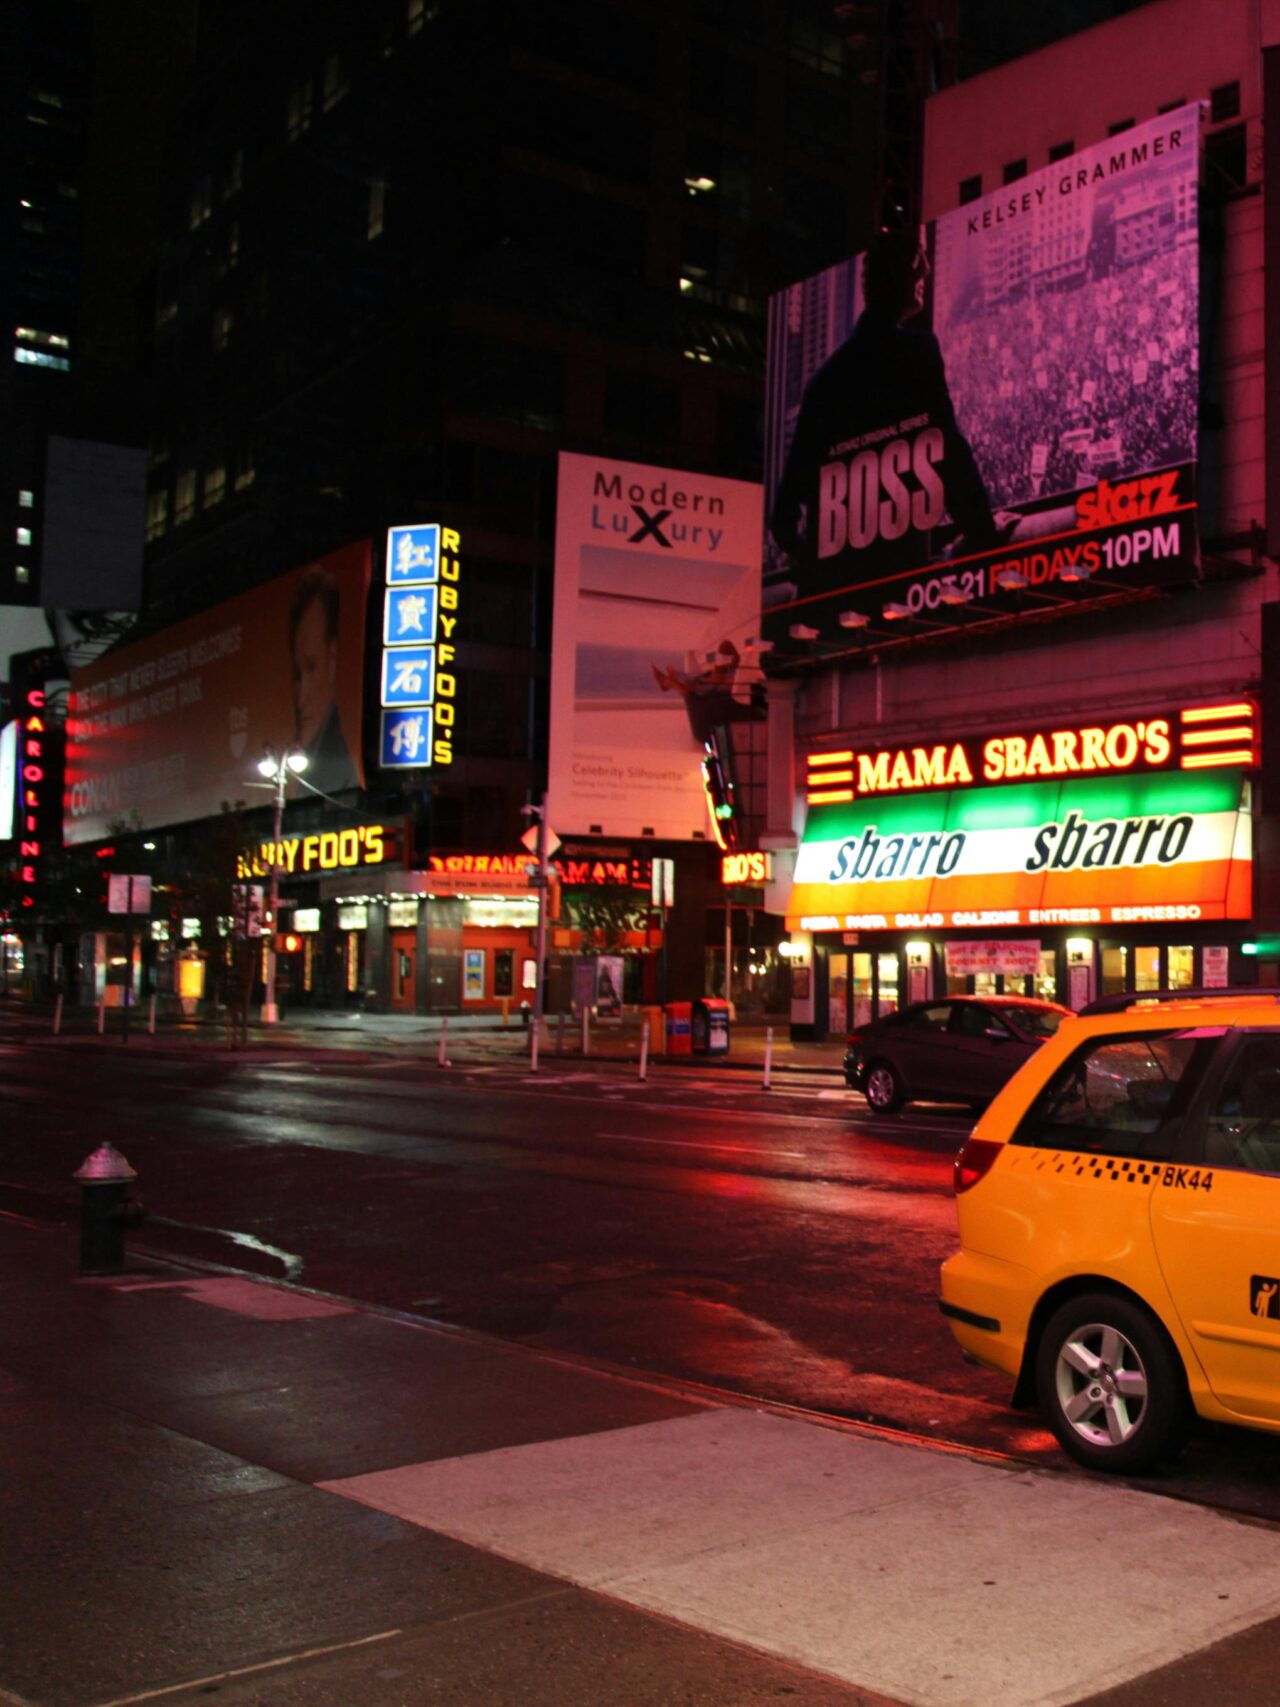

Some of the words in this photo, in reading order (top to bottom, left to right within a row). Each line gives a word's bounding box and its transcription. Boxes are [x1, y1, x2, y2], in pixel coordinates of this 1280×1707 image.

[967, 186, 1047, 235] KELSEY
[1058, 129, 1183, 196] GRAMMER
[593, 471, 724, 516] Modern
[817, 427, 945, 560] BOSS
[1075, 469, 1181, 531] starz
[989, 540, 1101, 595] FRIDAYS
[1101, 522, 1180, 569] 10PM
[857, 743, 973, 793] MAMA
[983, 720, 1171, 781] SBARRO'S
[303, 825, 384, 871] FOO'S
[829, 829, 968, 882] sbarro
[1026, 813, 1195, 873] sbarro
[894, 912, 945, 928] SALAD
[1029, 908, 1101, 923] ENTREES
[1111, 905, 1202, 921] ESPRESSO
[1162, 1166, 1214, 1193] 8K44
